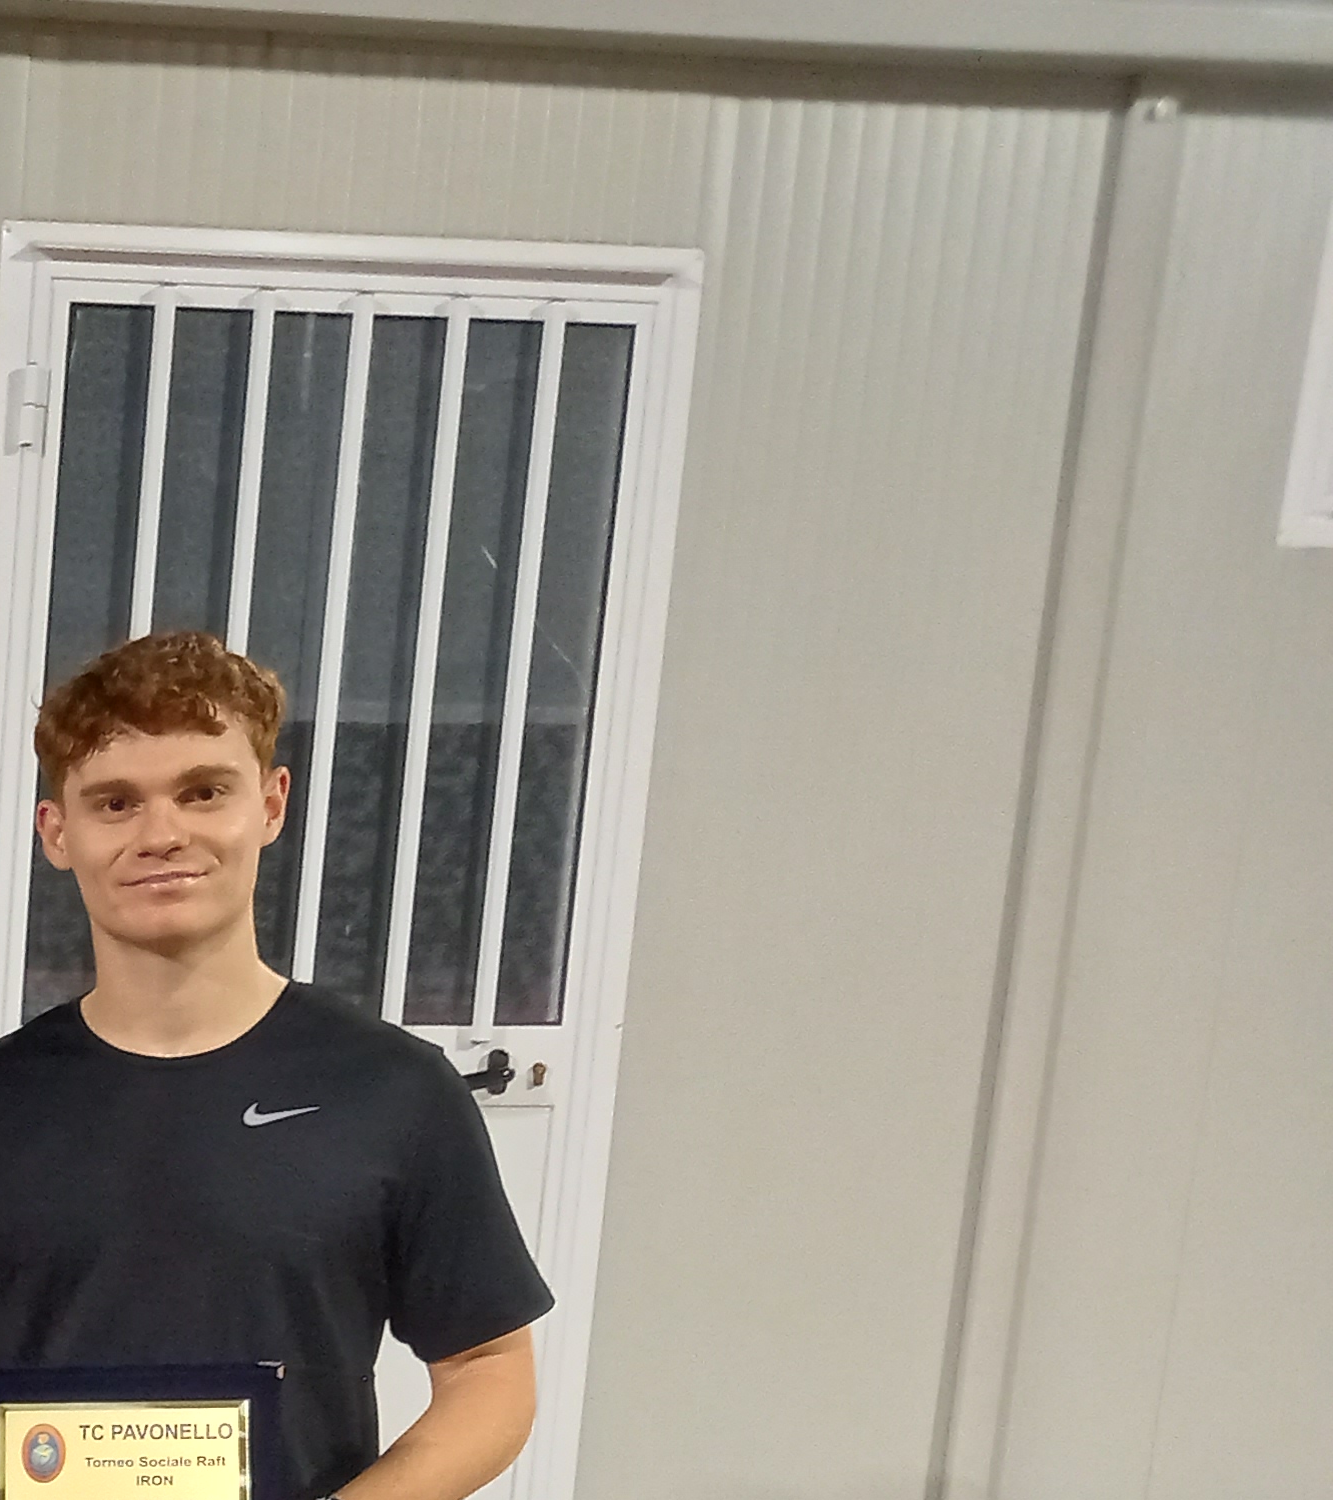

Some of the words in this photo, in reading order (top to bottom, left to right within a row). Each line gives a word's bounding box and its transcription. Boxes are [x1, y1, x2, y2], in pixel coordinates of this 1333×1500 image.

[79, 1424, 104, 1441] TC
[111, 1422, 233, 1441] PAVONELLO
[85, 1456, 134, 1468] Torneo
[139, 1455, 192, 1468] Sociale
[196, 1455, 226, 1467] Raft
[136, 1475, 174, 1486] IRON
